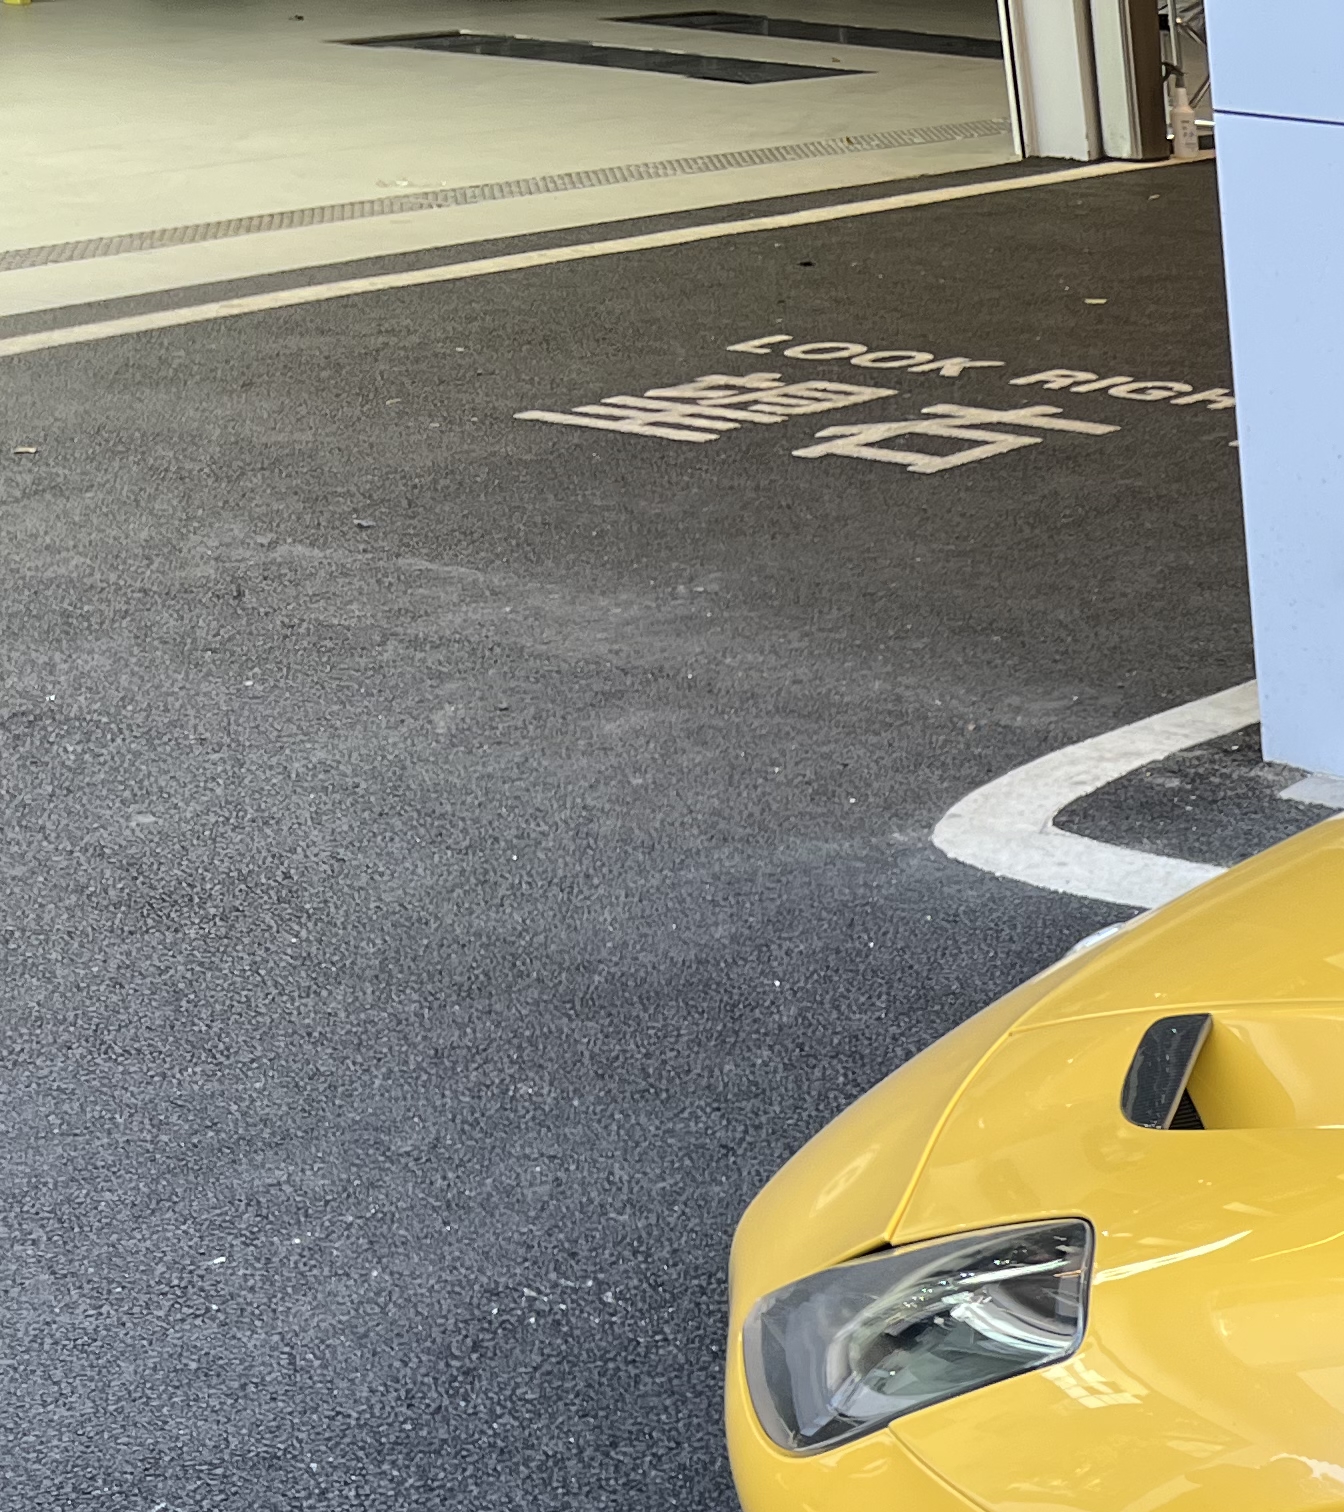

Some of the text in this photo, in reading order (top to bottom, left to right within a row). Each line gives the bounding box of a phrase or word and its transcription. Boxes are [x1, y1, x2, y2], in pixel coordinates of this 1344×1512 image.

[726, 334, 1236, 411] LOOK RIGH
[512, 372, 1122, 474] 望右
